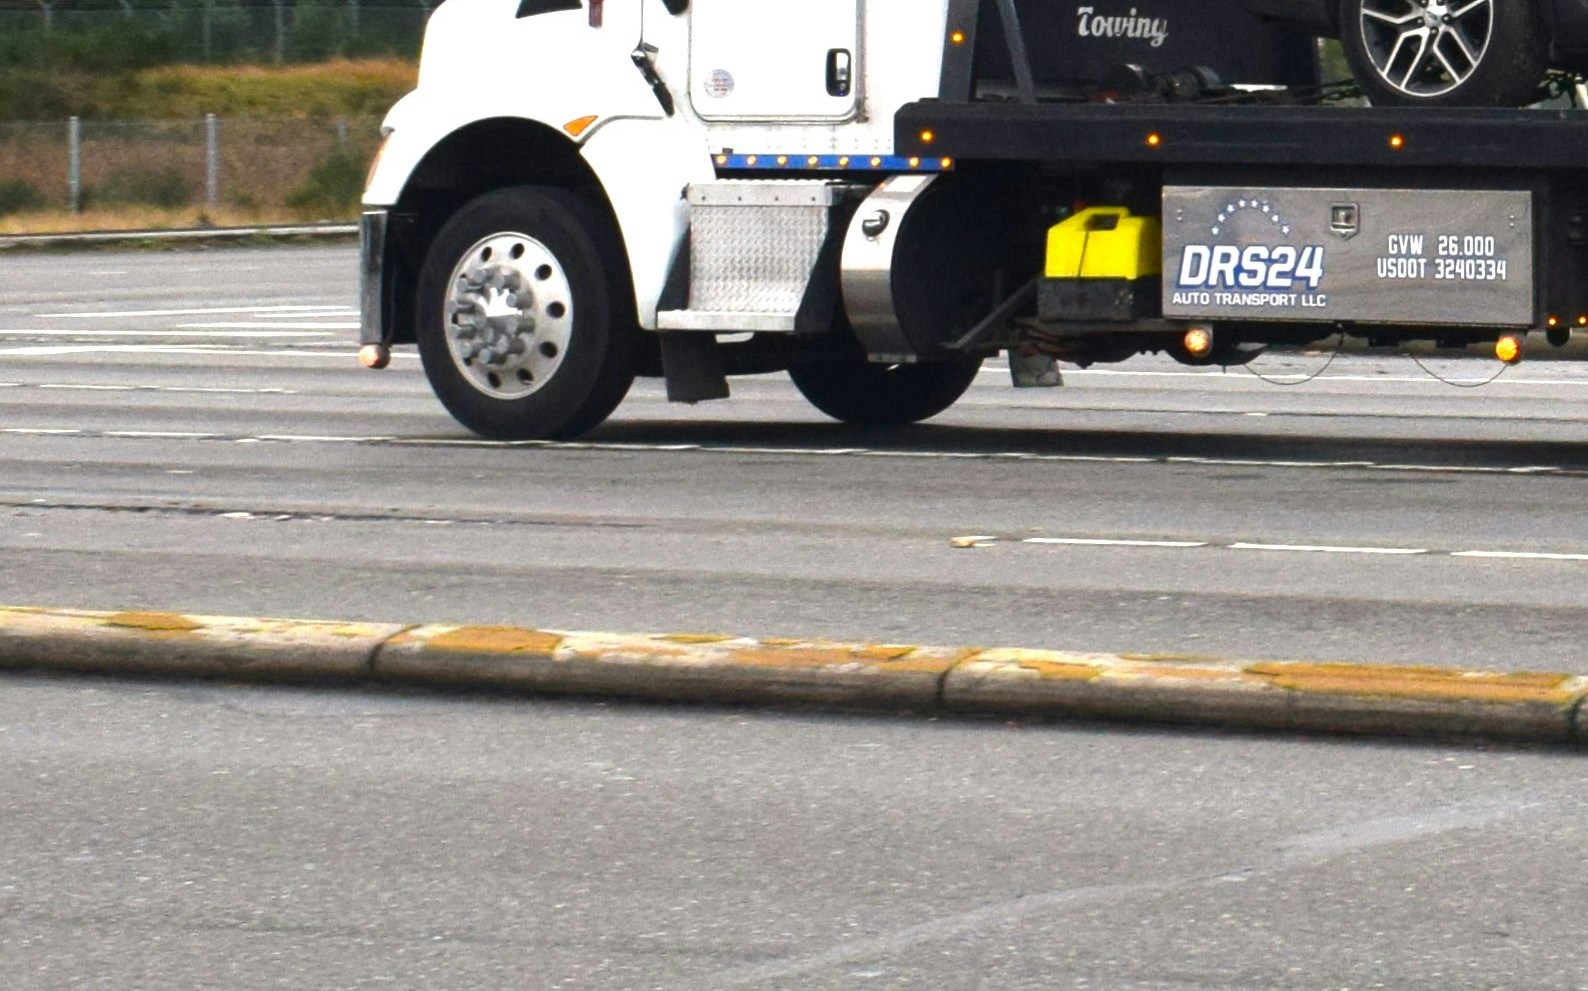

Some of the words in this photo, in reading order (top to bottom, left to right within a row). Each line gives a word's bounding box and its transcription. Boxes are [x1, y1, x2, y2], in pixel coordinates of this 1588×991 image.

[1077, 6, 1169, 48] Towing
[1388, 234, 1424, 255] GVW
[1178, 244, 1325, 288] DRS24
[1377, 257, 1427, 279] USDOT
[1434, 258, 1507, 280] 3240334
[1172, 292, 1210, 305] AUTO
[1214, 293, 1297, 306] TRANSPORT
[1301, 294, 1327, 307] LLC
